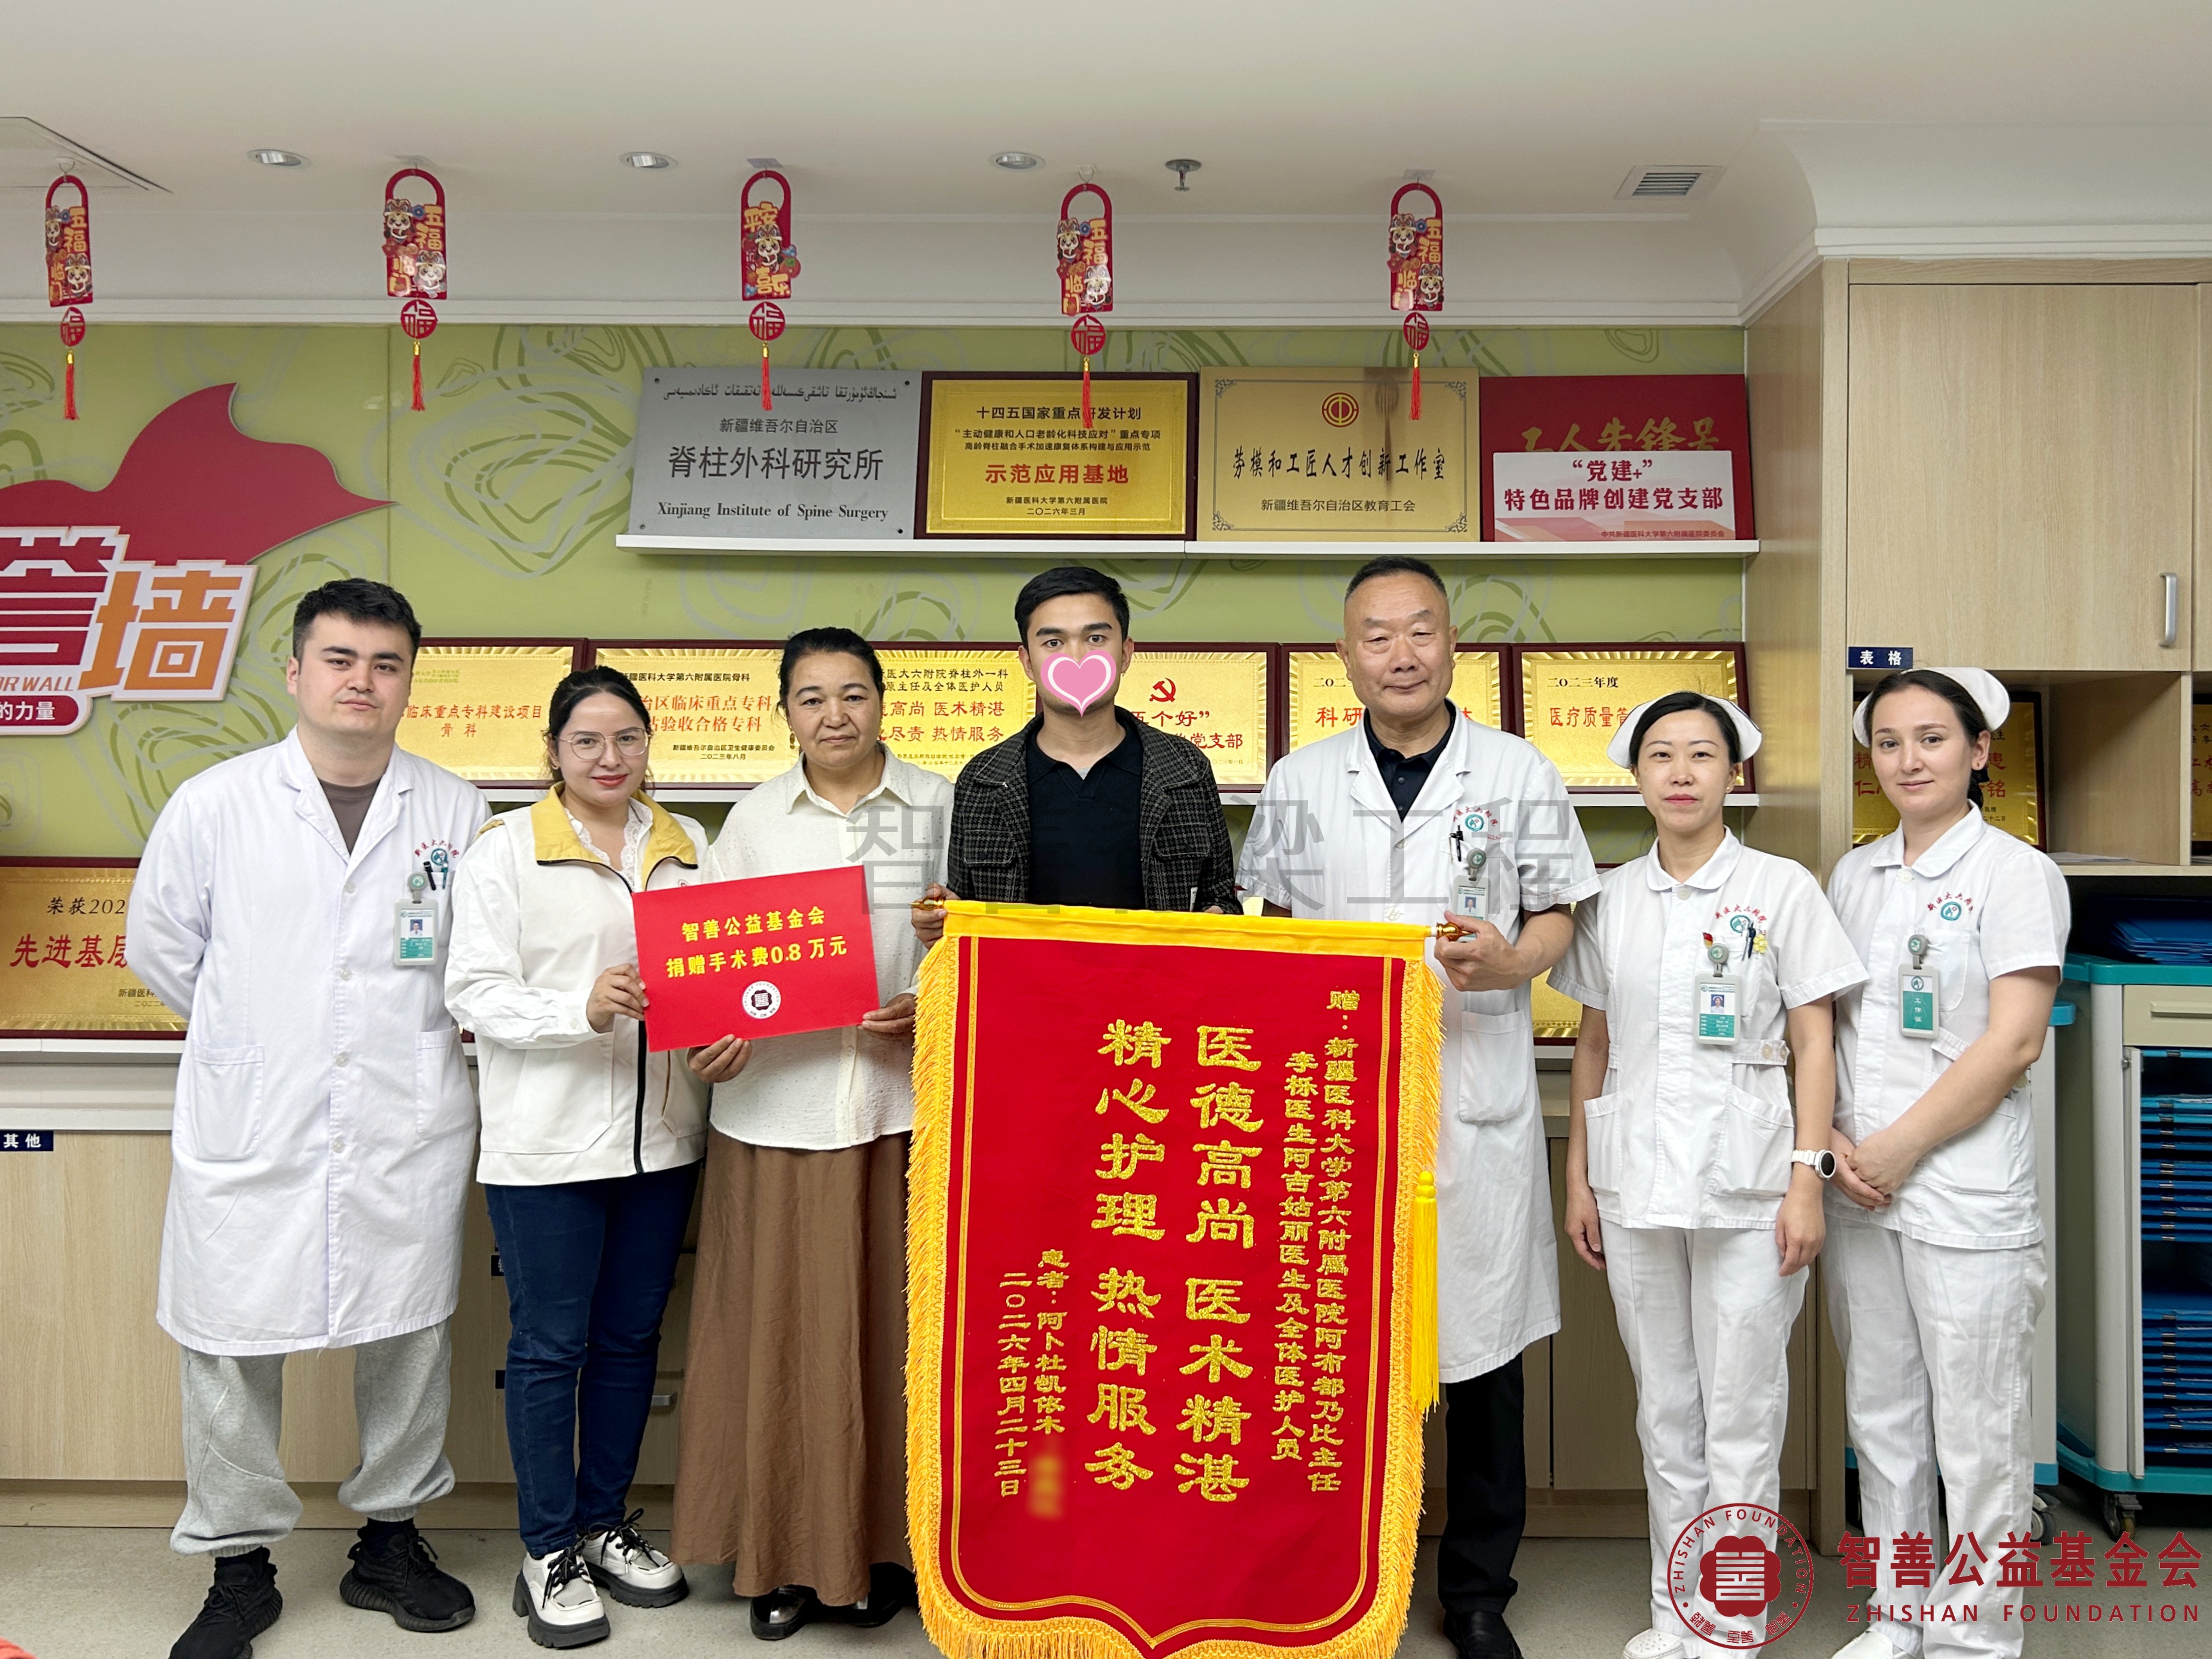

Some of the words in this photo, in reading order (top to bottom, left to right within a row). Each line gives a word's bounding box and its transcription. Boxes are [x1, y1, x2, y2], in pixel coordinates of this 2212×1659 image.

[744, 203, 778, 232] 平安
[1083, 219, 1107, 265] 五福
[1418, 218, 1441, 263] 五福
[401, 301, 436, 339] 福
[751, 303, 784, 340] 福
[1073, 317, 1105, 354] 福
[719, 418, 838, 433] 新疆维吾尔自治区
[668, 446, 884, 480] 脊柱外科研究所
[1233, 445, 1446, 481] 劳模和工匠人才创新工作室
[1572, 459, 1653, 482] “党建+”
[985, 464, 1128, 484] 示范应用基地
[1006, 496, 1108, 505] 新疆医科大学第六附属医院
[1261, 499, 1416, 512] 新疆维吾尔自治区教育工会
[1504, 487, 1723, 511] 特色品牌创建党支部
[658, 502, 710, 519] Xinjiang
[717, 503, 771, 517] Institute
[778, 504, 791, 516] of
[798, 504, 832, 520] Spine
[838, 505, 889, 521] Surgery
[1027, 508, 1085, 516] 二〇二六年三月
[1601, 530, 1724, 538] 中共新疆医科大学第六附属医院委员会
[1860, 650, 1902, 666] 表格
[22, 677, 74, 691] WALL
[883, 669, 1009, 679] 医大六附院脊柱外一科
[1547, 677, 1619, 688] 二〇二三年度
[0, 701, 56, 721] 的力量
[401, 704, 542, 719] 临床重点专科建设项目
[934, 701, 1005, 716] 医术精湛
[1315, 707, 1363, 728] 科研
[441, 723, 476, 737] 骨科
[932, 726, 1004, 742] 热情服务
[1175, 733, 1243, 749] 党支部
[47, 897, 126, 915] 荣获202
[681, 906, 825, 943] 智善公益基金会
[10, 934, 128, 968] 先进基层
[118, 989, 157, 998] 新疆医科
[1091, 1019, 1172, 1241] 精心护理
[1186, 1025, 1264, 1249] 医德高尚
[3, 1133, 41, 1148] 其他
[1084, 1267, 1161, 1490] 热情服务
[1174, 1278, 1253, 1502] 医术精湛
